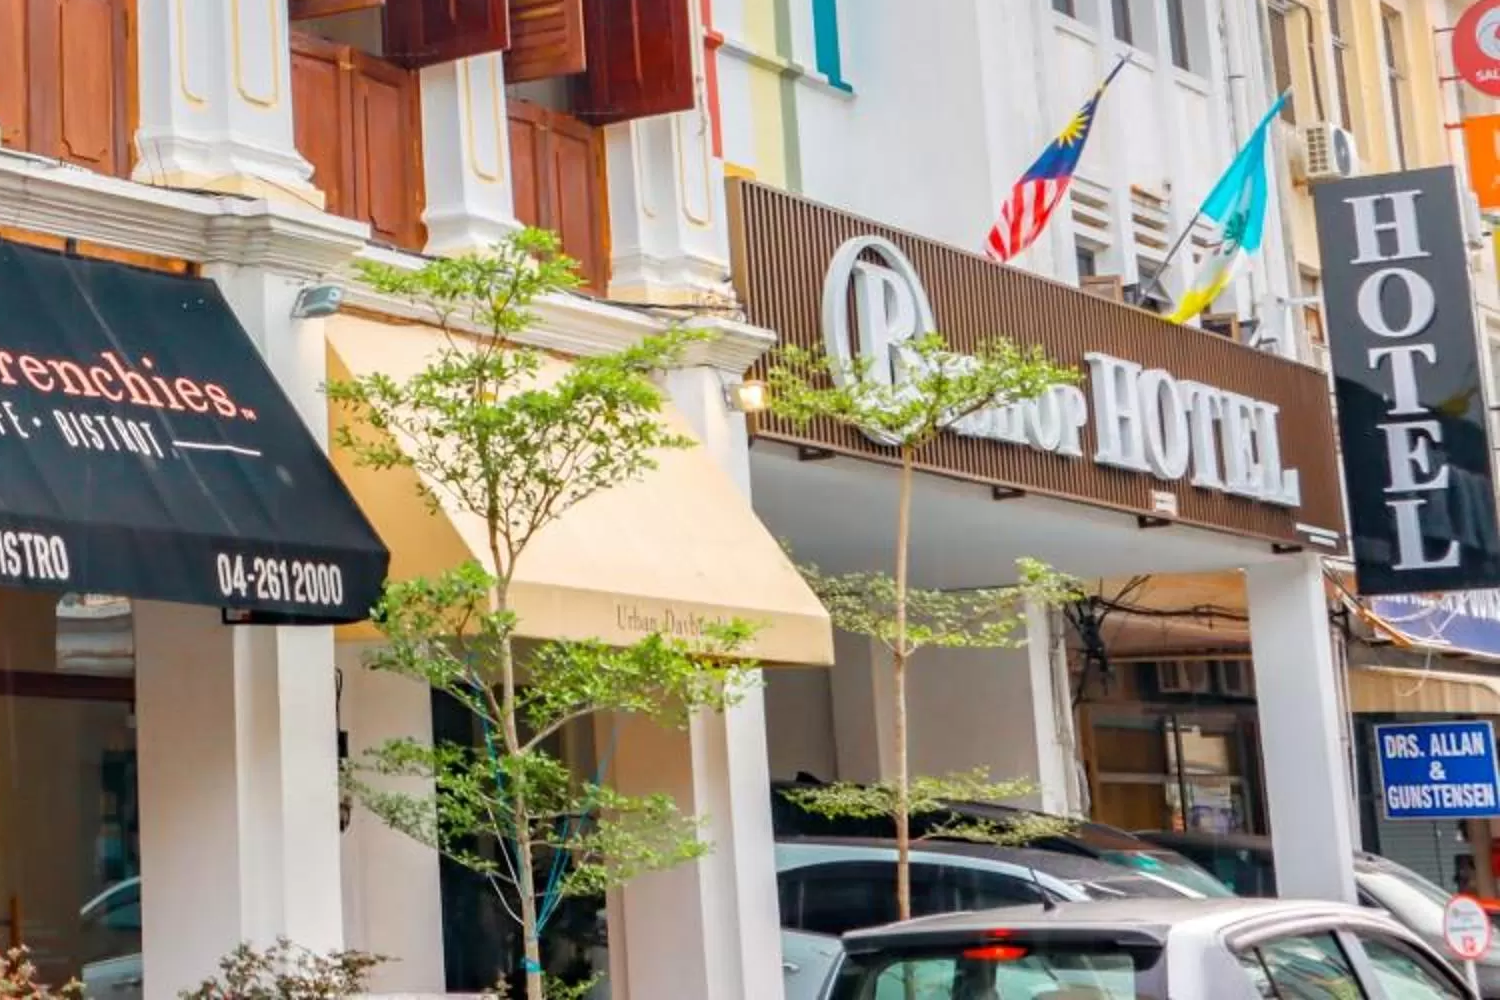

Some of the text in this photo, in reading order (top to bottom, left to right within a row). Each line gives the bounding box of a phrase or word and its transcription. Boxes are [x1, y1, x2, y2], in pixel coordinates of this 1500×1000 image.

[1343, 189, 1460, 571] HOTEL
[53, 409, 164, 458] BISTROT
[1083, 351, 1300, 507] HOTEL
[1384, 731, 1485, 759] DRS. ALLAN
[1429, 760, 1446, 780] &
[1387, 783, 1496, 810] GUNSTENSEN
